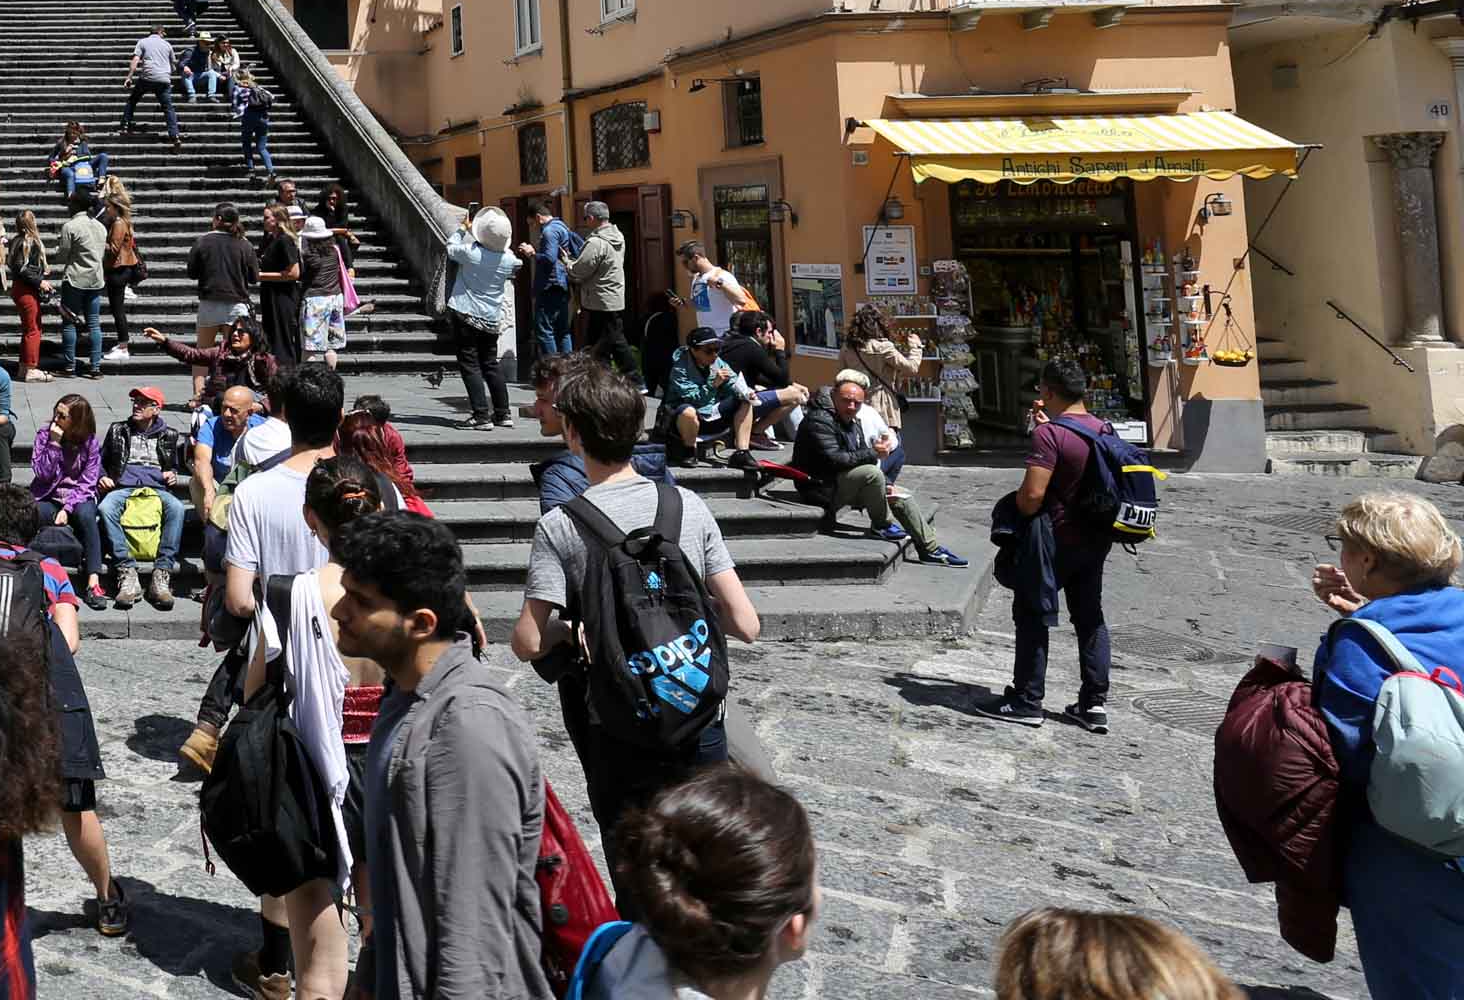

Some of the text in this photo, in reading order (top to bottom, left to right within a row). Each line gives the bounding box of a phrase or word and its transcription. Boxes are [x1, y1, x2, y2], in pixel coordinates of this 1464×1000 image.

[1430, 104, 1449, 117] 40
[1001, 157, 1061, 177] Antichi
[1069, 156, 1129, 177] Sapori
